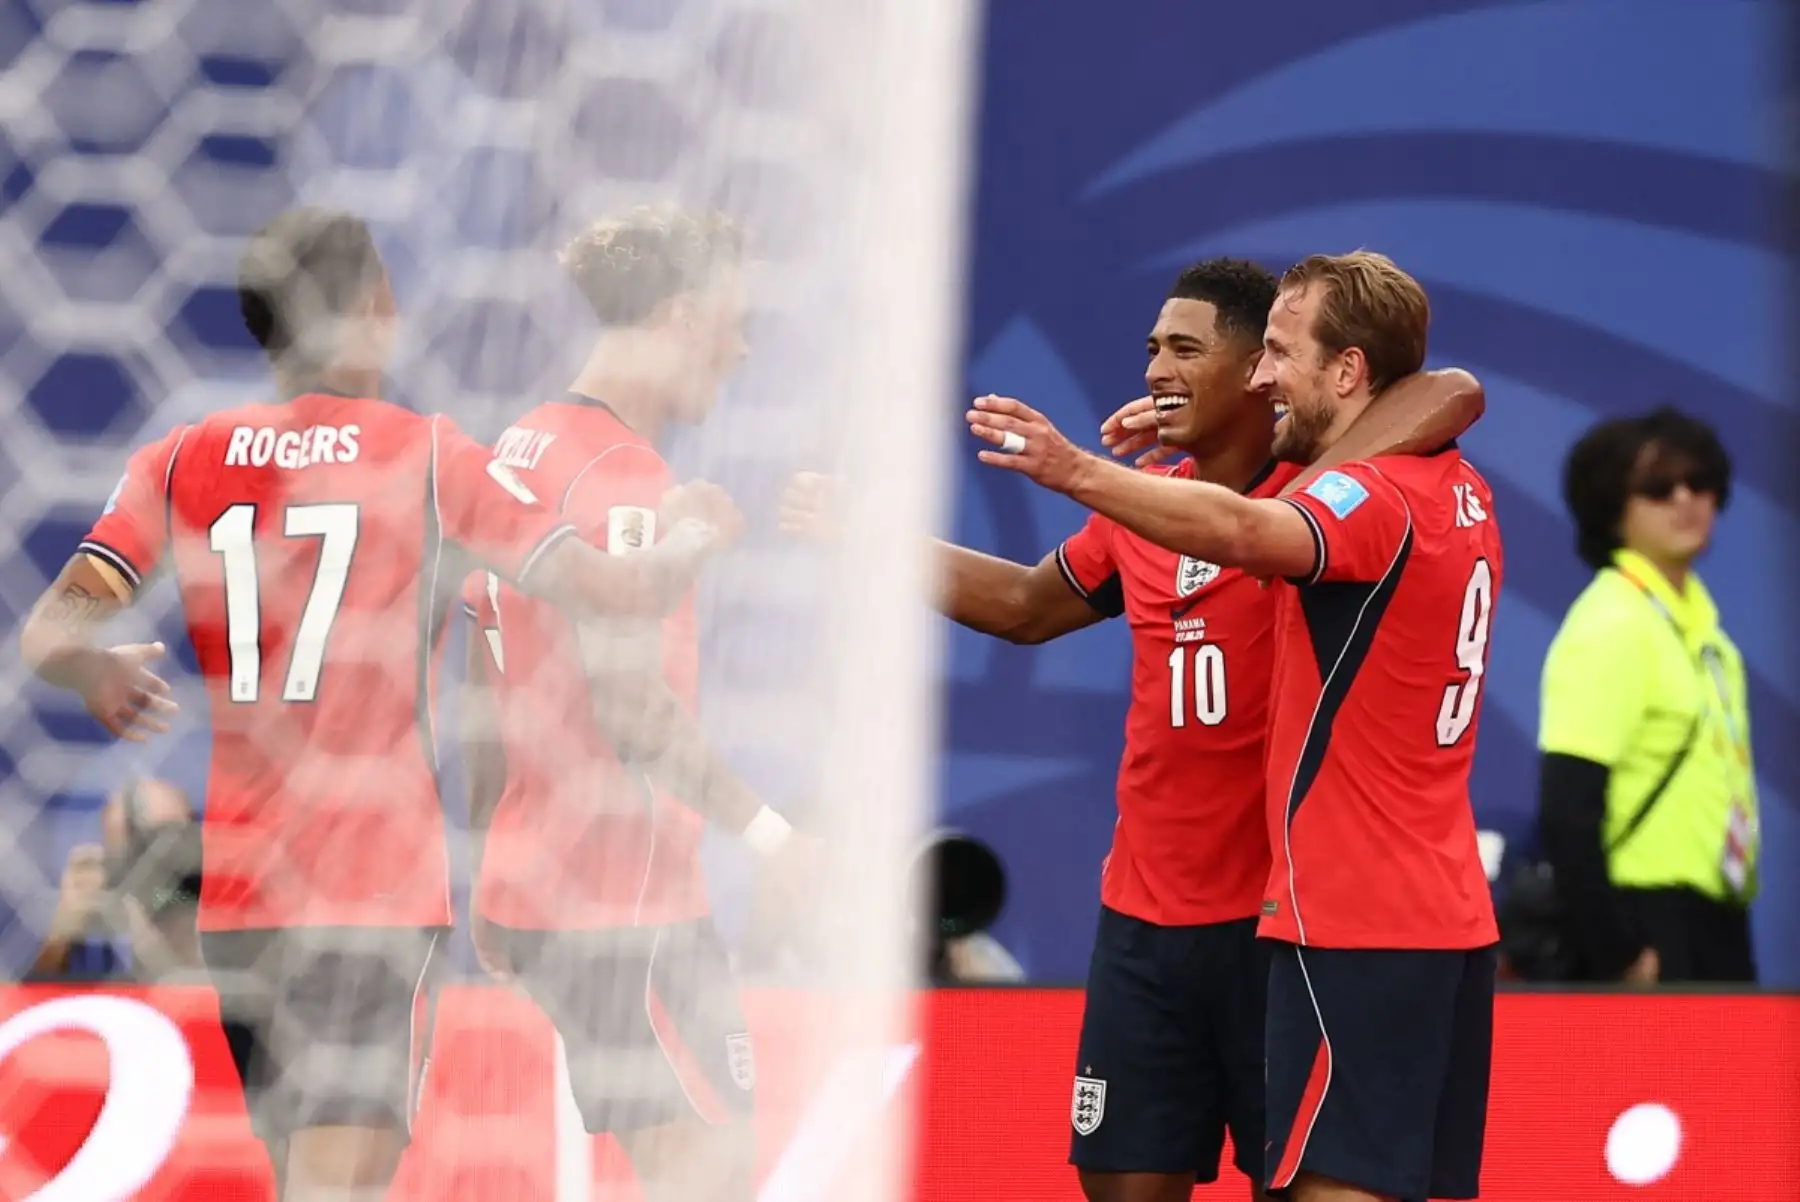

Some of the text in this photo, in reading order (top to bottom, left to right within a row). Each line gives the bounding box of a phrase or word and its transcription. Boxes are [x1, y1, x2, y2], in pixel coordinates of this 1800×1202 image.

[224, 424, 361, 469] ROGERS
[208, 503, 359, 703] 17
[1174, 617, 1206, 631] PANAMA
[1168, 643, 1227, 728] 10
[1435, 557, 1492, 748] 9
